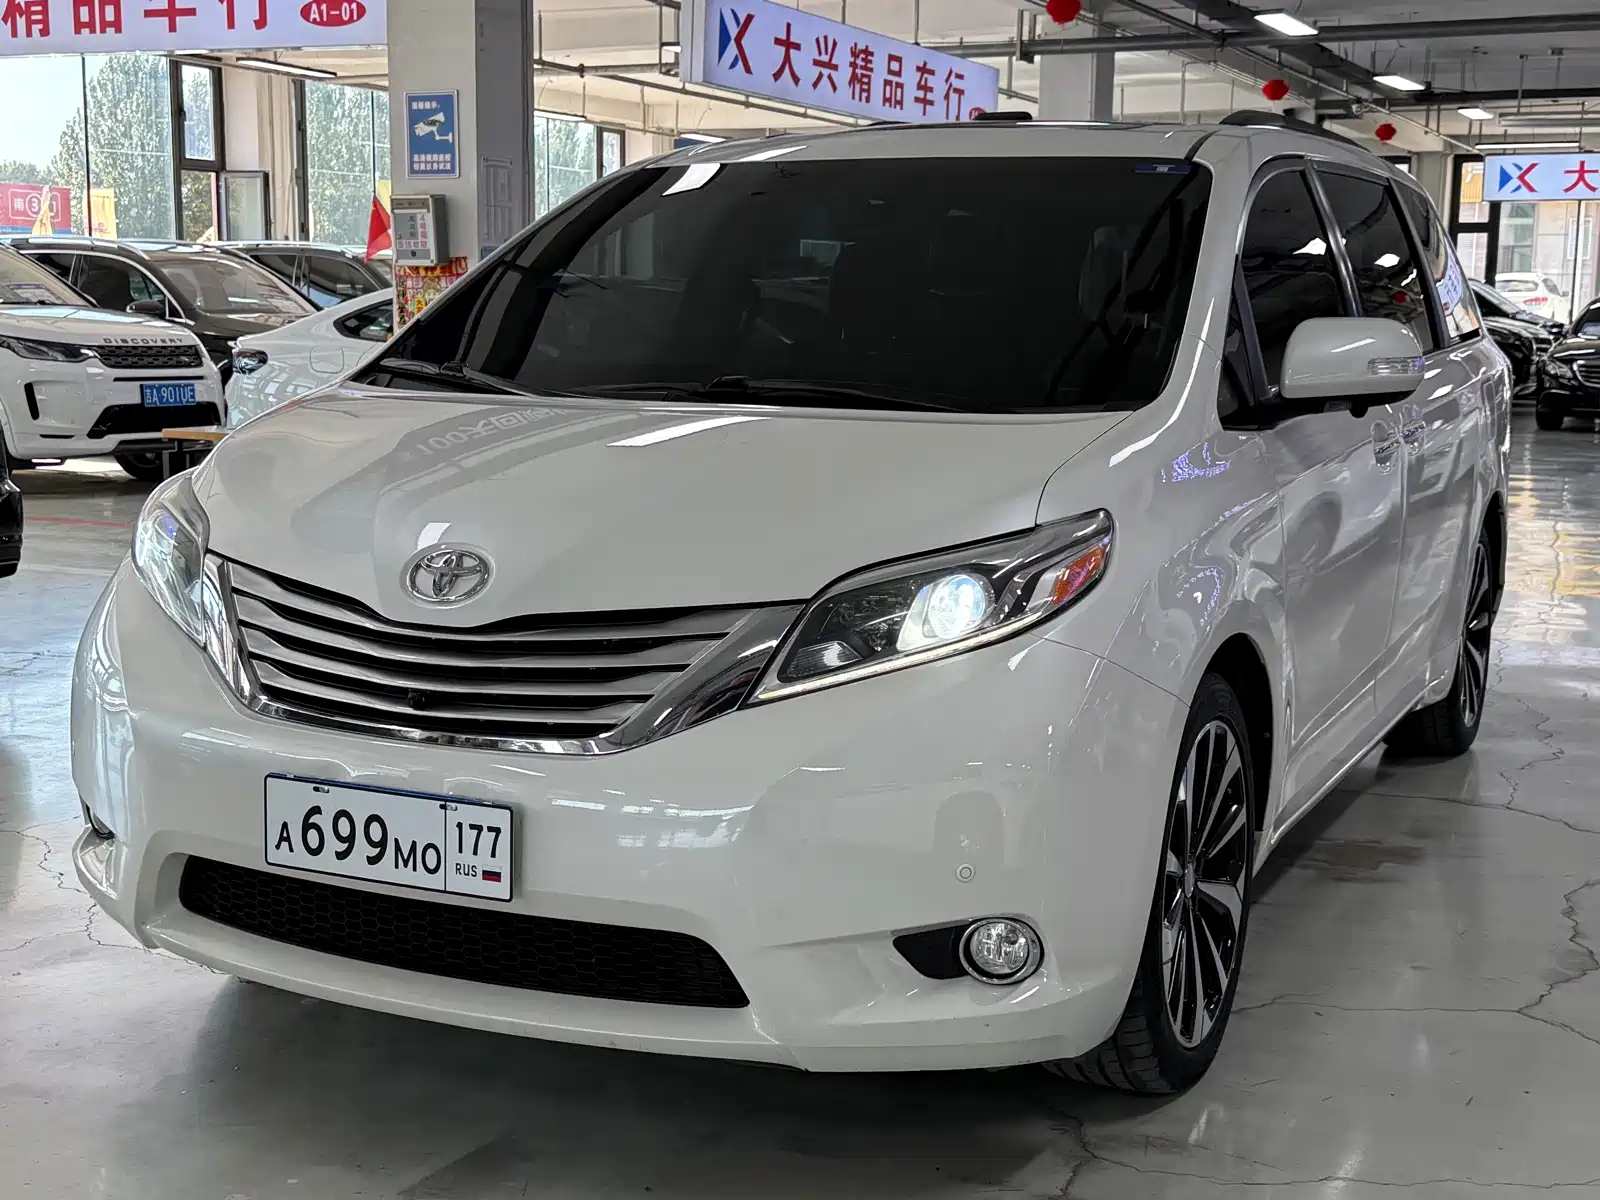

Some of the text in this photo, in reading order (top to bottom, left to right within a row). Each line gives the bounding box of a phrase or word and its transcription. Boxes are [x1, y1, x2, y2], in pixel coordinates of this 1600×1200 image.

[309, 2, 358, 23] A1-01
[772, 21, 966, 121] 大兴精品车行
[1562, 160, 1600, 193] 大
[102, 337, 184, 346] DISCOVERY
[455, 822, 502, 858] 177
[455, 863, 478, 878] RUS
